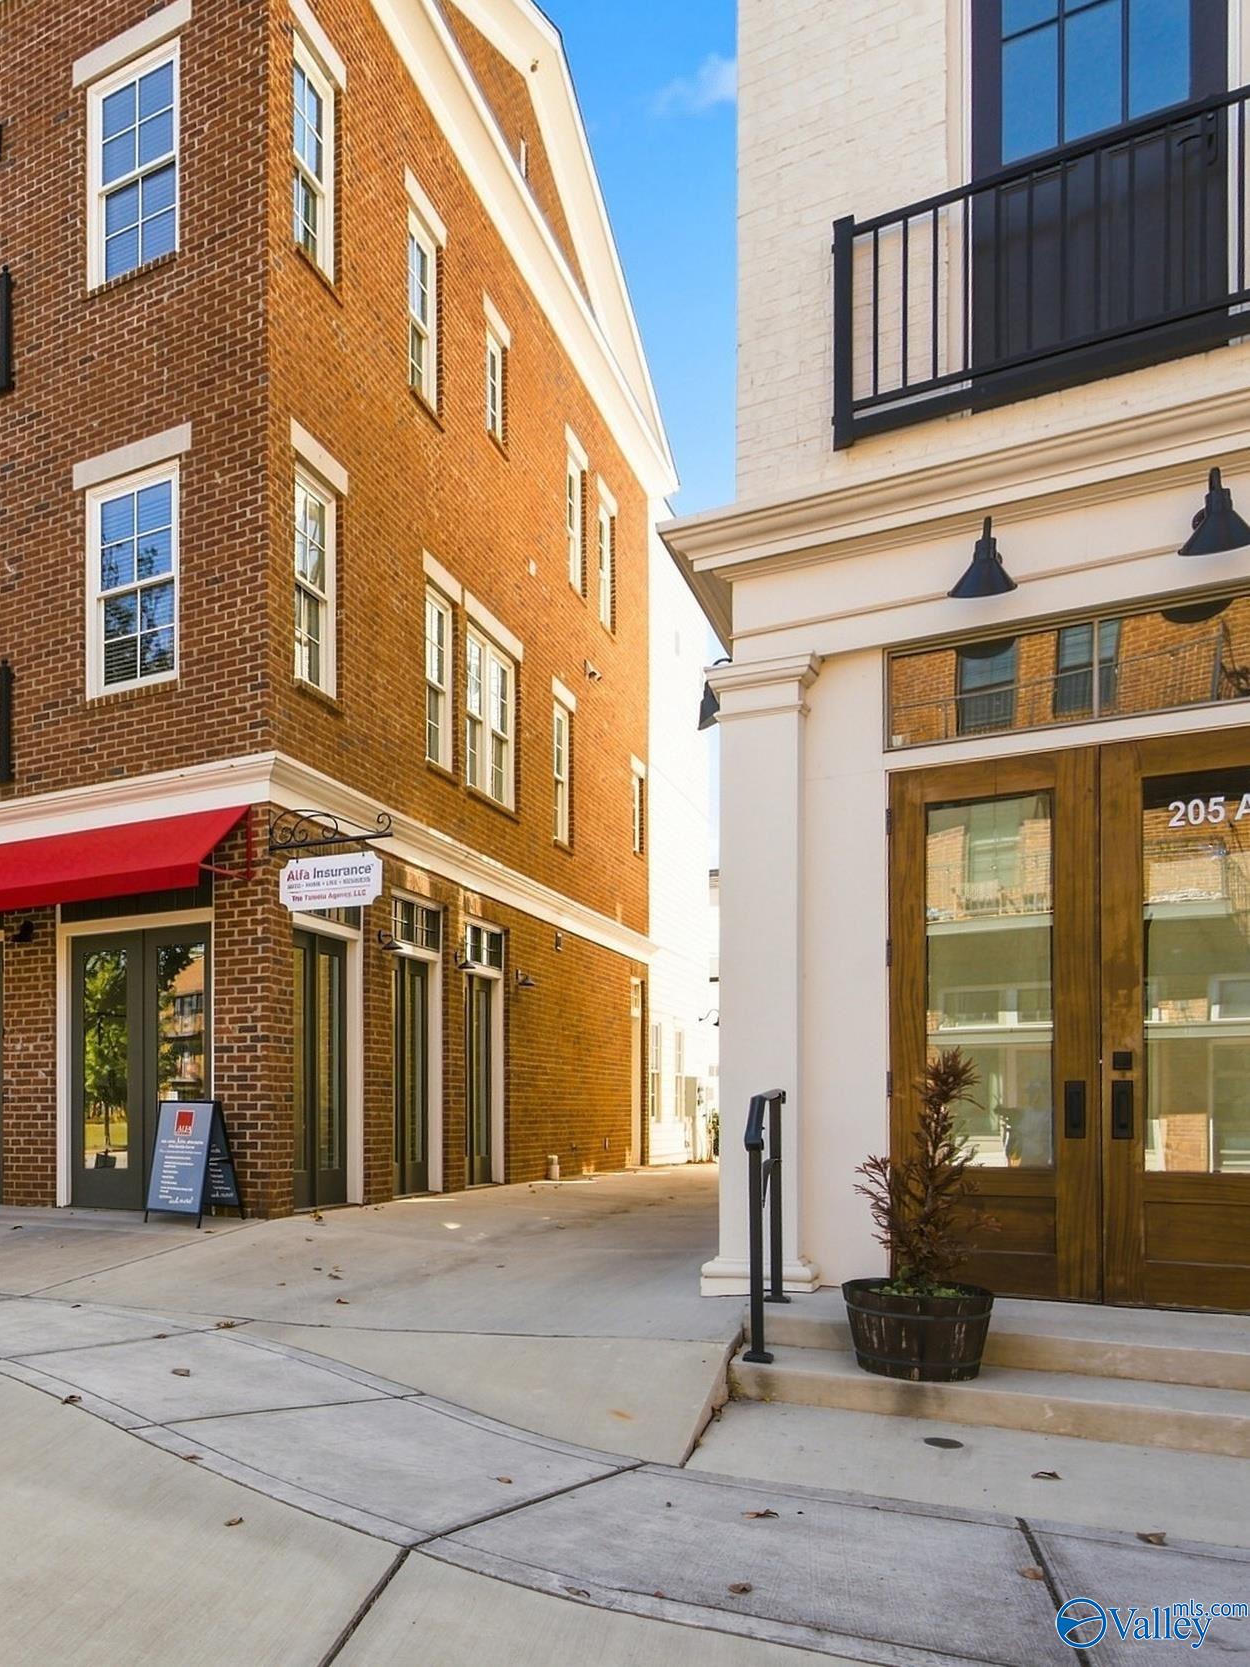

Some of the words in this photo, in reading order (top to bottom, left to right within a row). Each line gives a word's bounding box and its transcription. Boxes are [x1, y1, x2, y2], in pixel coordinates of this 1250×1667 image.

[1168, 796, 1225, 827] 205
[287, 868, 310, 881] Alfa
[313, 863, 372, 879] Insurance
[353, 889, 367, 897] LLC
